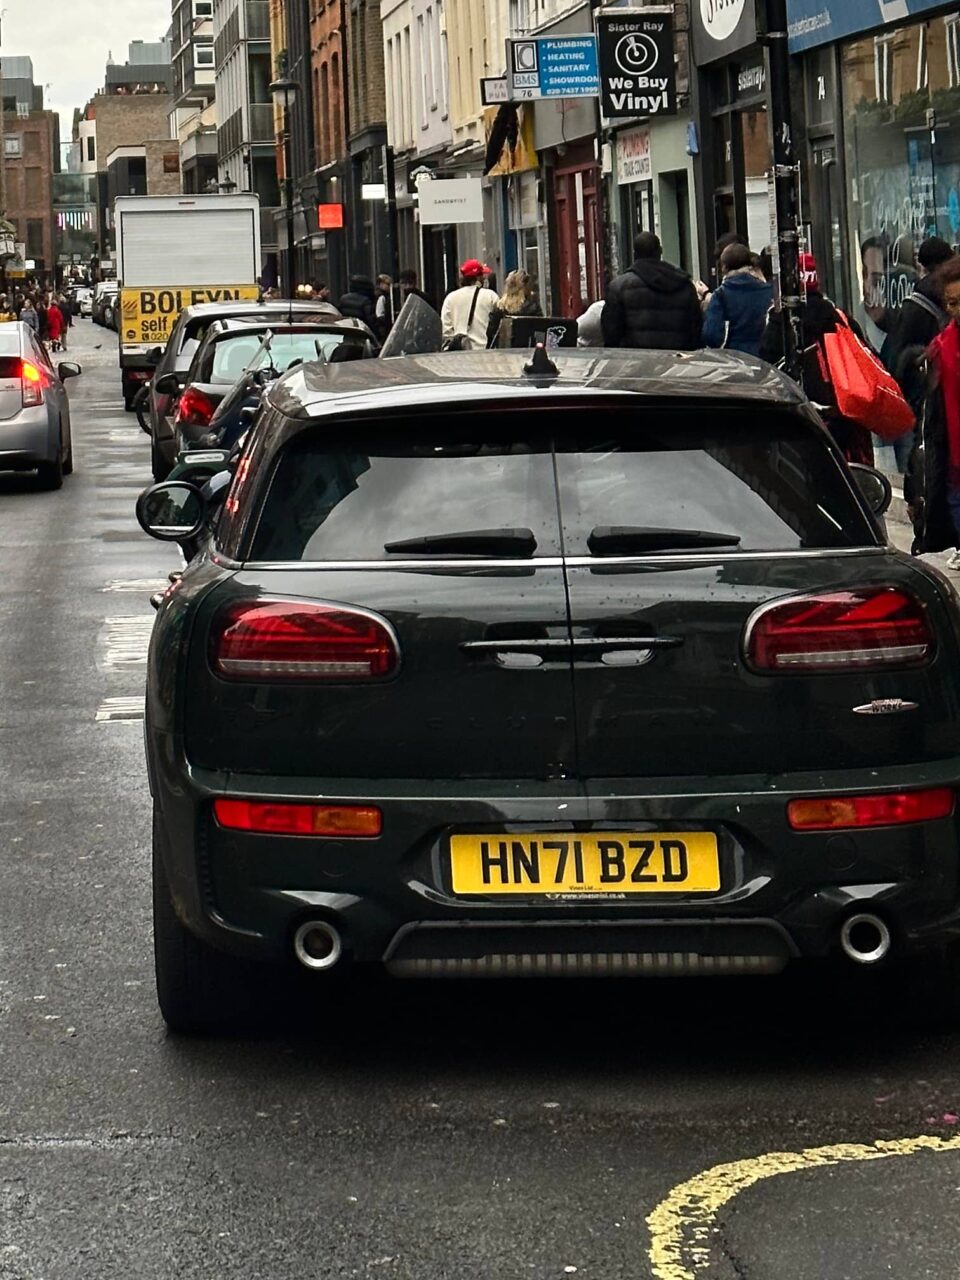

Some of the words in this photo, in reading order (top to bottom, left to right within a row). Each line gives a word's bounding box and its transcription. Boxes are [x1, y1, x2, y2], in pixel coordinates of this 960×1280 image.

[608, 23, 640, 32] Sister
[643, 21, 664, 32] Ray
[547, 40, 592, 49] PLUMBING
[548, 52, 585, 61] HEATING
[548, 64, 590, 72] SANITARY
[514, 75, 537, 86] BMS
[608, 77, 633, 89] We
[638, 76, 668, 90] Buy
[521, 89, 533, 98] 76
[609, 91, 669, 113] Vinyl
[141, 316, 167, 332] self
[150, 332, 168, 341] 020
[481, 841, 584, 884] HN71
[597, 839, 688, 882] BZD
